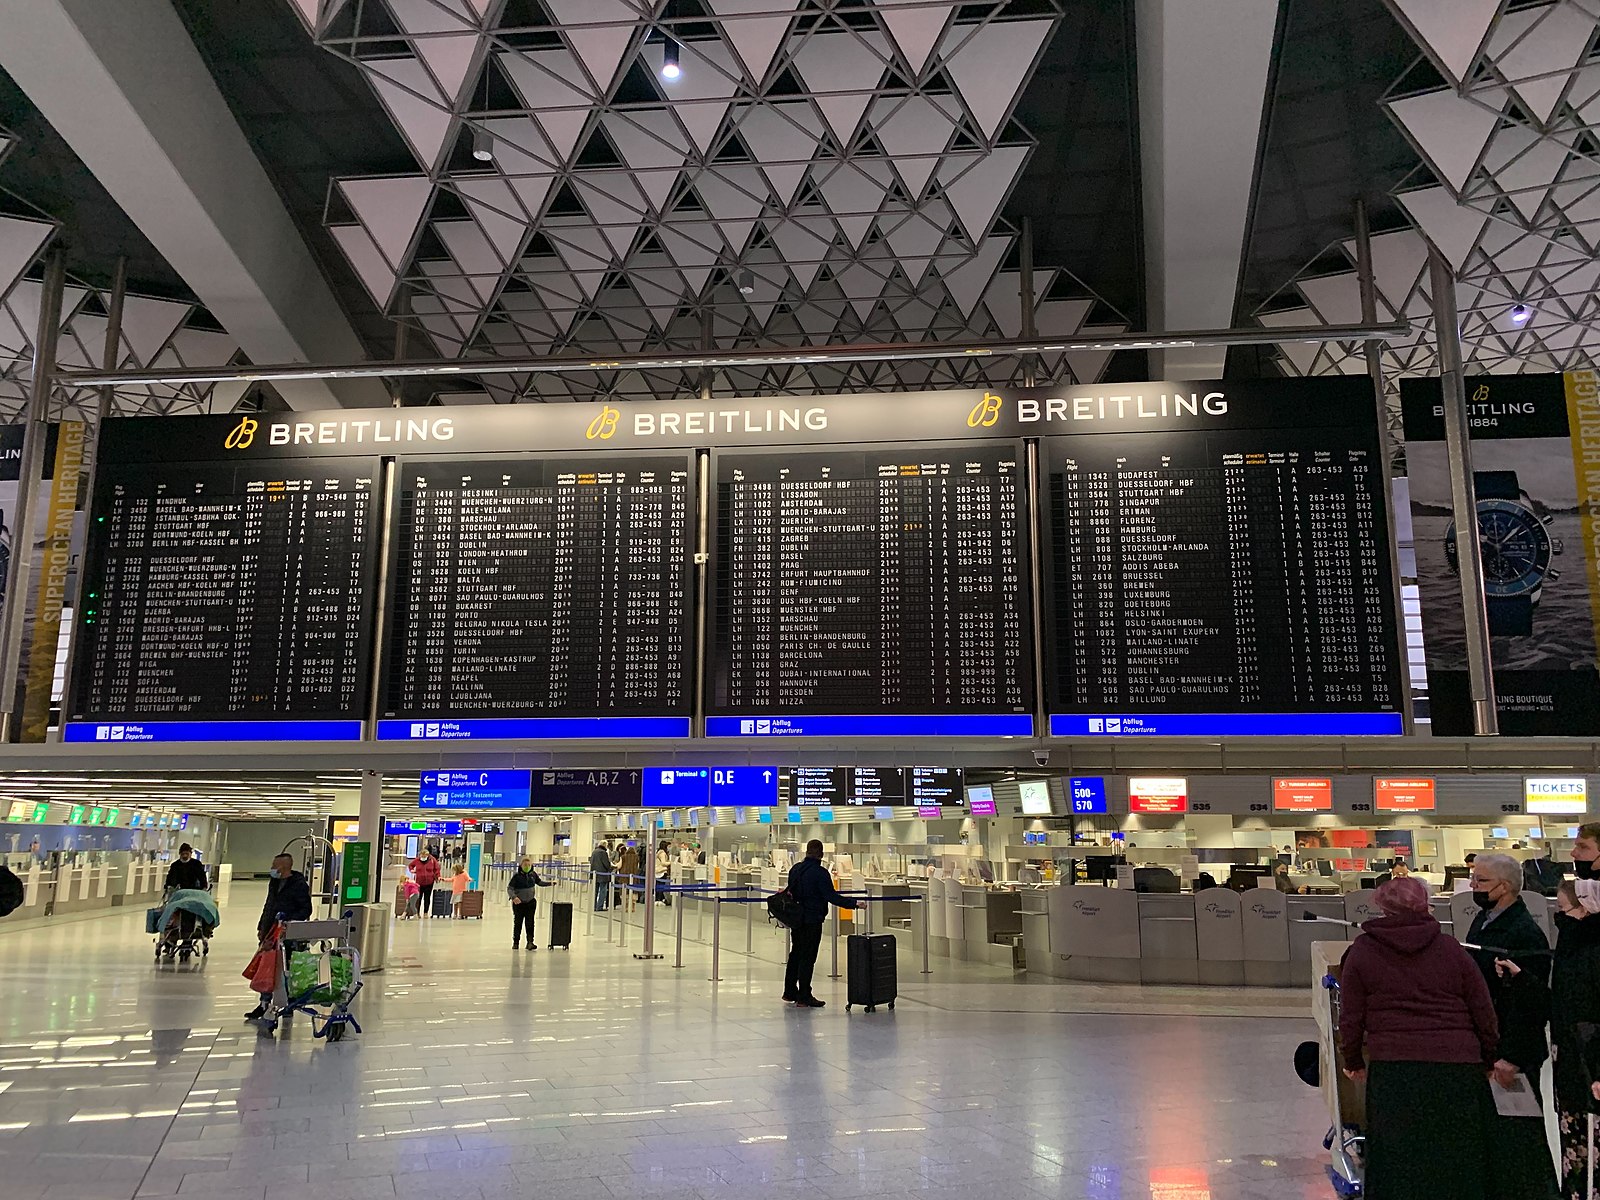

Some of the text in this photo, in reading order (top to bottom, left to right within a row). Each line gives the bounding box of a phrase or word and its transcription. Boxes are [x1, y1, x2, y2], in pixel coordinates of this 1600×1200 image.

[1018, 393, 1227, 422] BREITLING
[634, 408, 828, 435] BREITLING
[1470, 418, 1498, 427] 1884
[270, 418, 454, 445] BREITLING
[58, 422, 86, 504] HERITAGE
[43, 508, 75, 623] SUPEROCEAN
[772, 719, 791, 727] Abflug
[1123, 718, 1143, 726] Abflug
[480, 774, 487, 786] C
[587, 772, 619, 786] A,B,Z
[1074, 789, 1096, 798] 500-
[1530, 784, 1583, 792] TICKETS
[1076, 801, 1092, 810] 570
